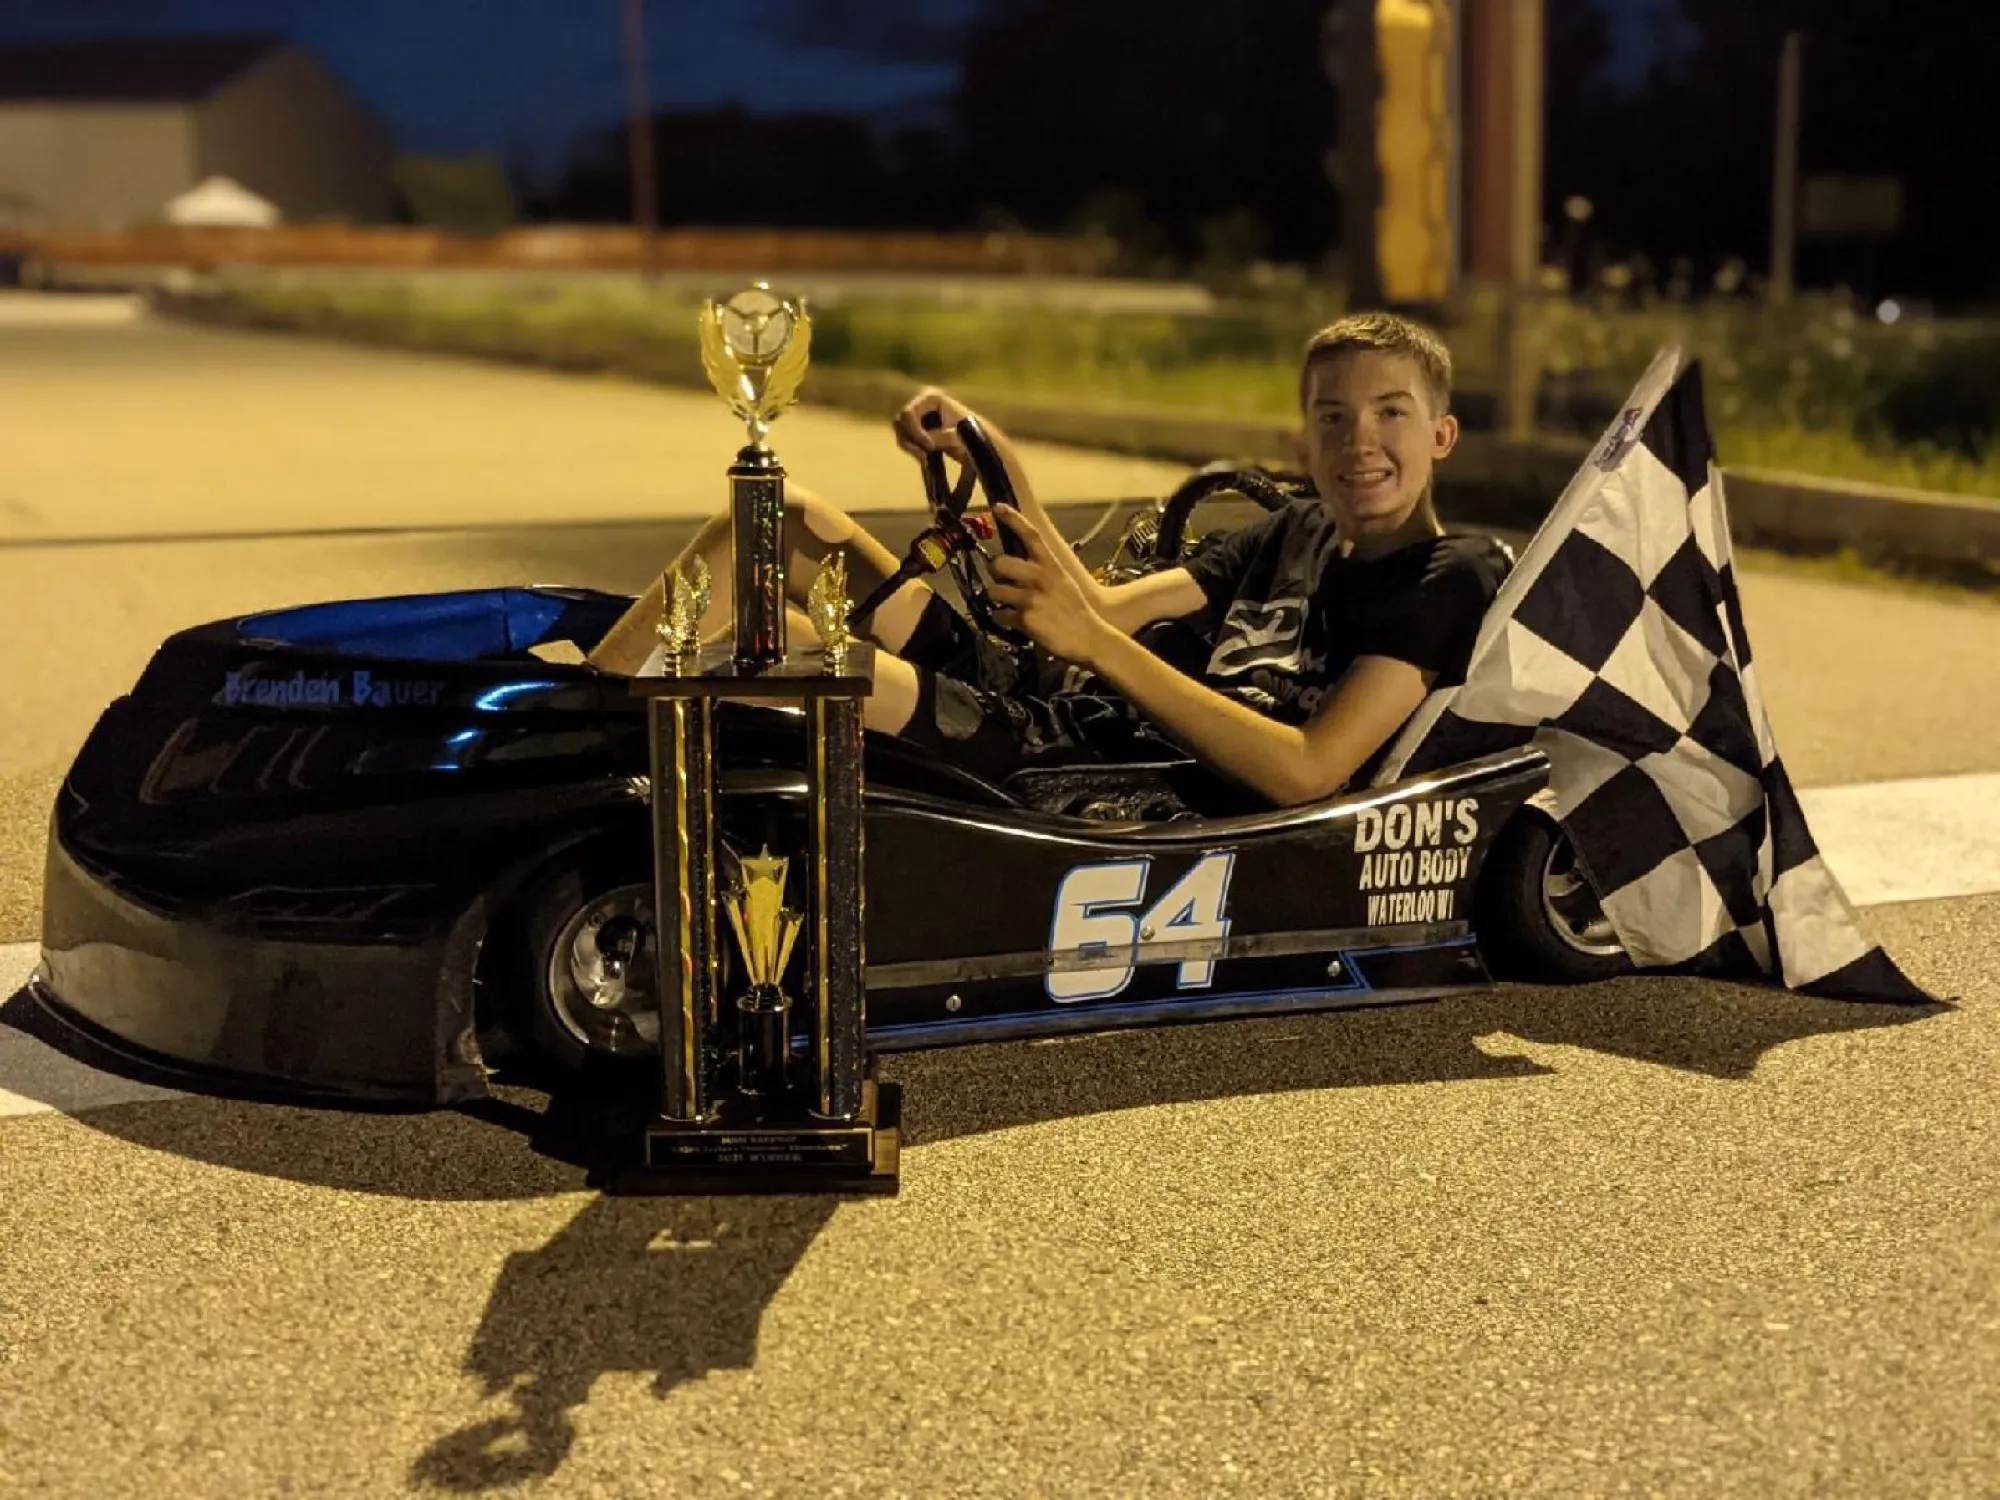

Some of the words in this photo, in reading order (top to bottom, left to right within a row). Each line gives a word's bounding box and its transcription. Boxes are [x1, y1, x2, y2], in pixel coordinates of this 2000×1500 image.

[223, 670, 341, 707] Brenden
[353, 670, 447, 707] Bauer
[1354, 799, 1479, 854] DON'S
[1359, 852, 1414, 891] AUTO
[1417, 846, 1473, 885] BODY
[1044, 852, 1236, 1003] 64
[1367, 890, 1436, 927] WATERLOO
[1437, 889, 1455, 920] WI
